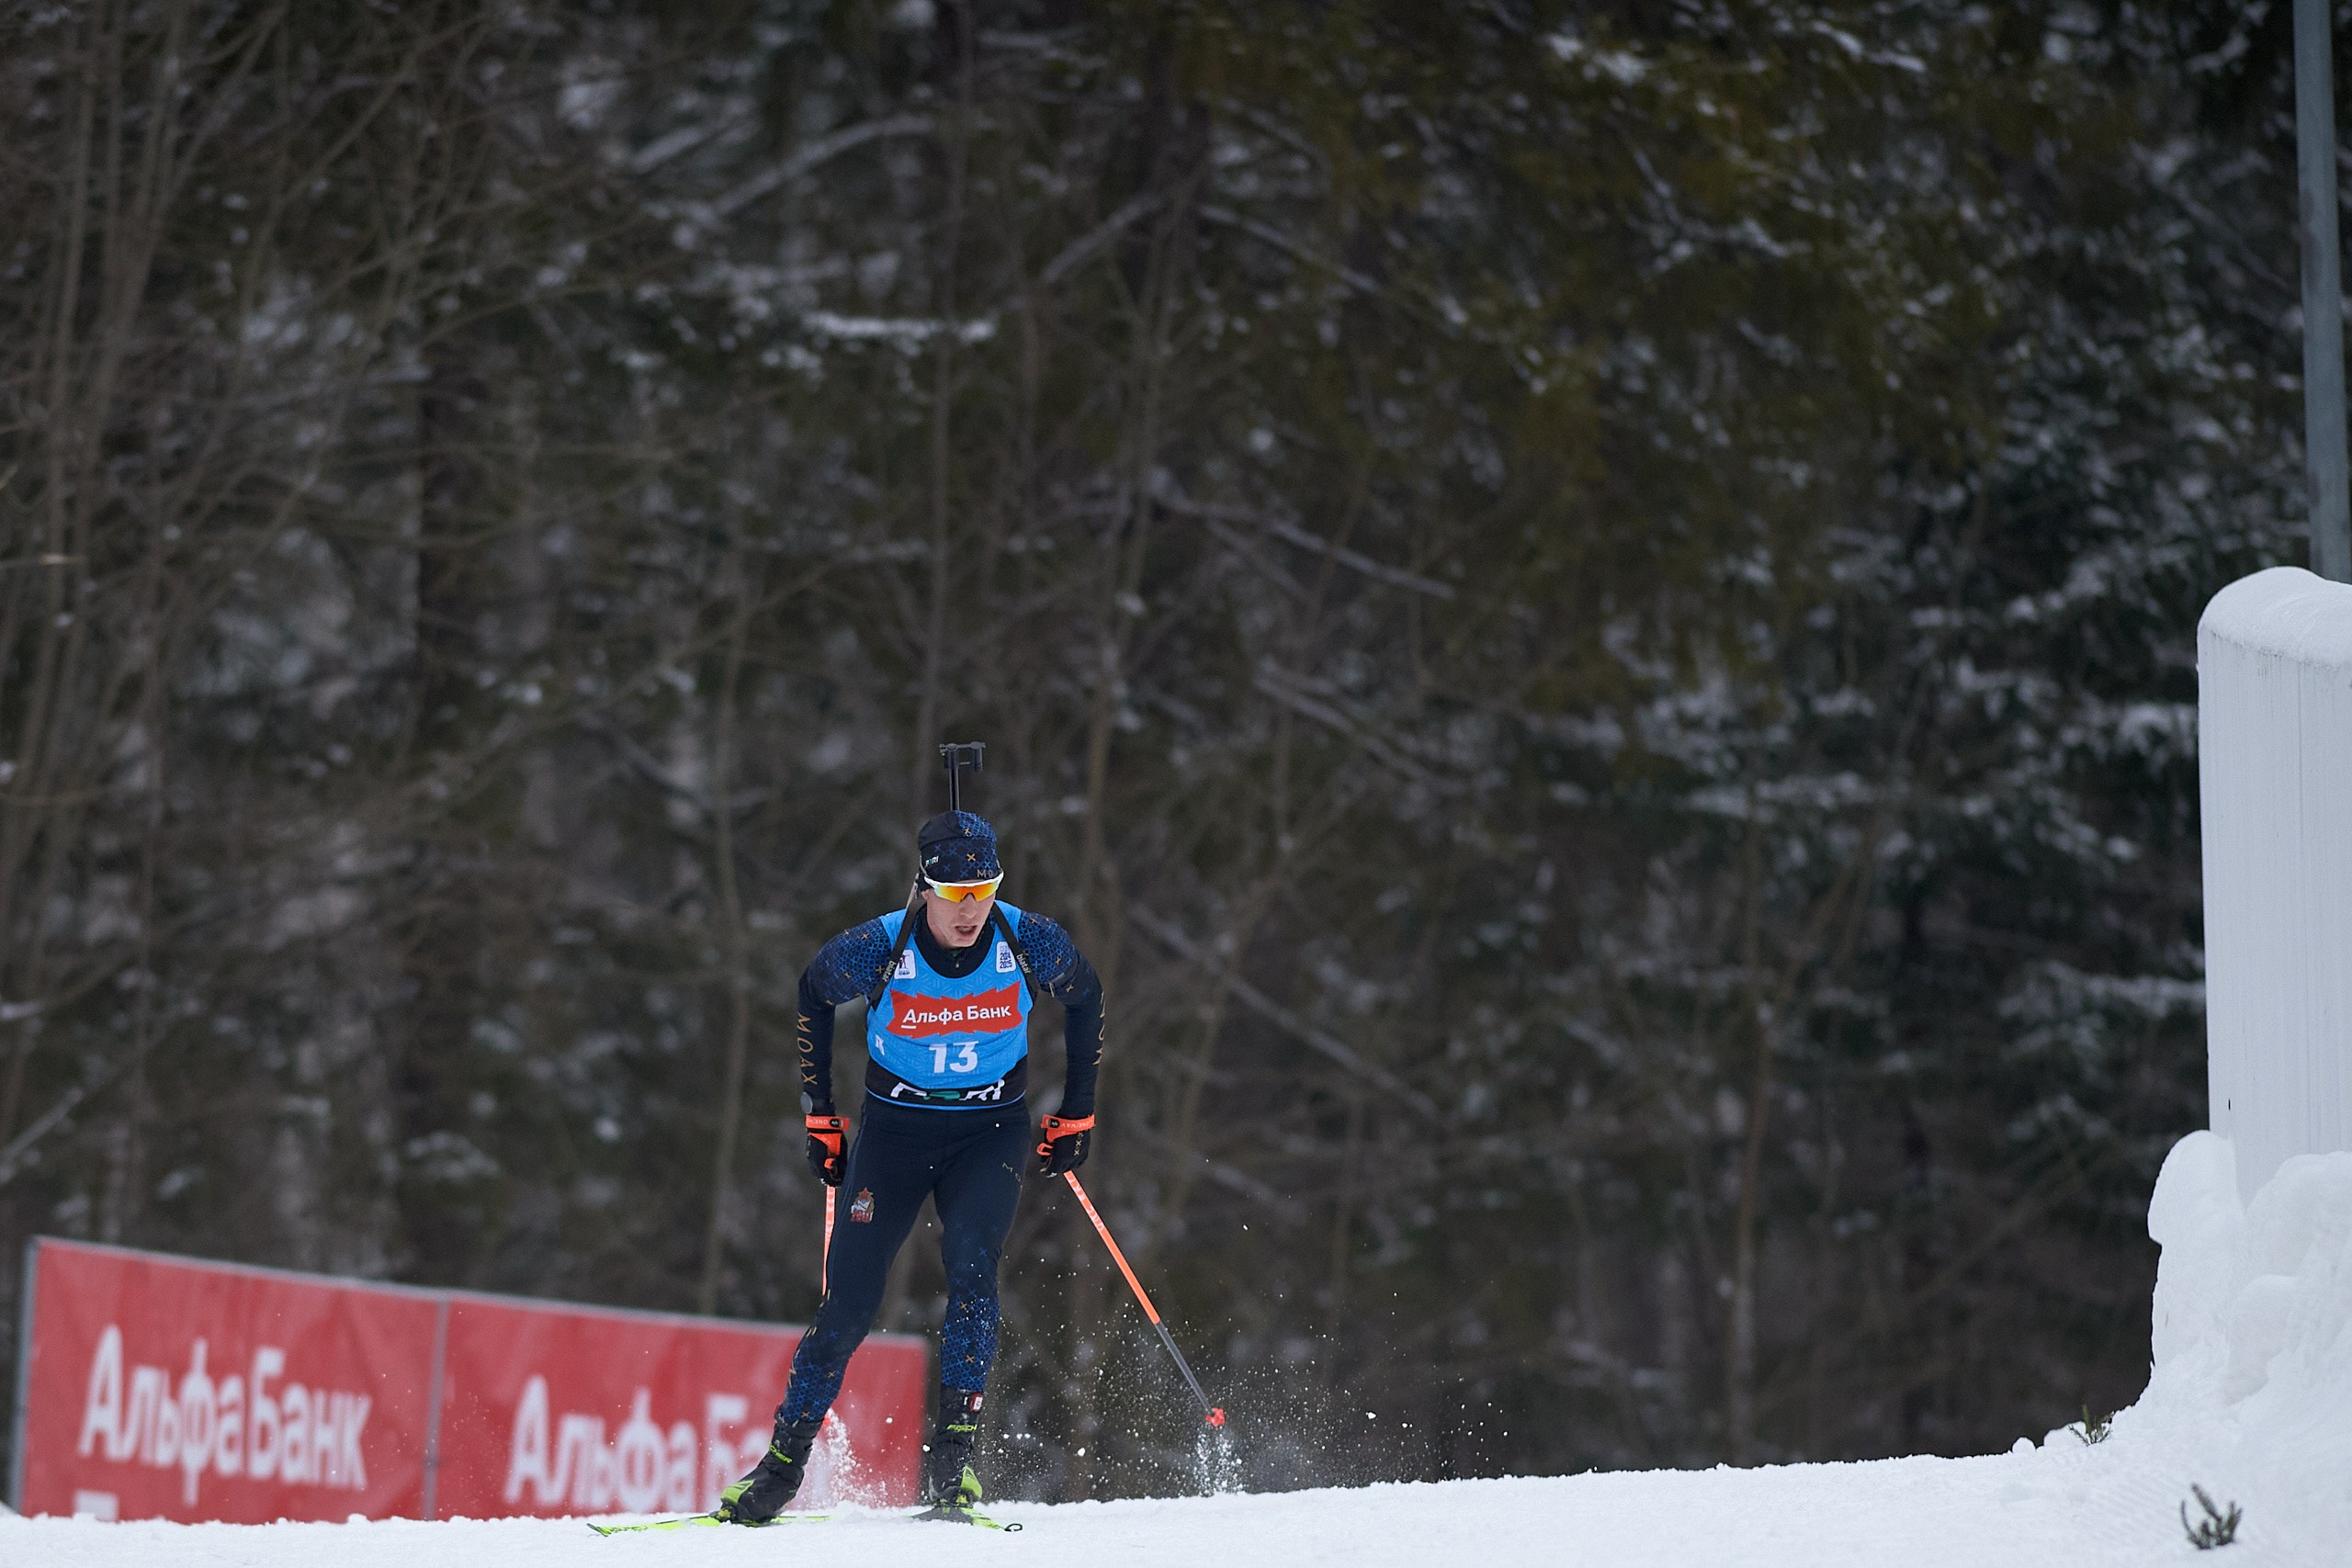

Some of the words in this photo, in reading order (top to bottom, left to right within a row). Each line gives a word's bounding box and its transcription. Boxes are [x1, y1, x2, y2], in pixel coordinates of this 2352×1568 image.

[902, 1008, 964, 1025] Альфа
[967, 1005, 1012, 1021] Банк
[929, 1041, 979, 1074] 13
